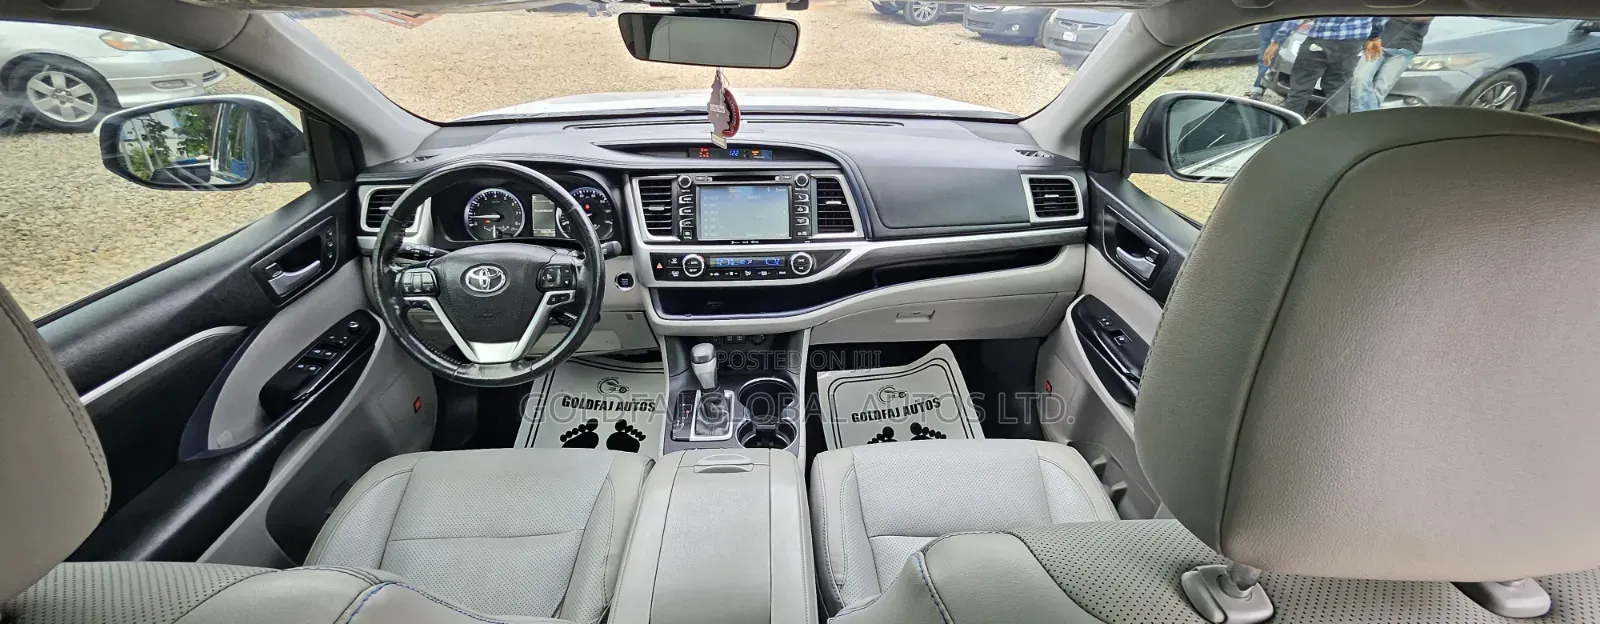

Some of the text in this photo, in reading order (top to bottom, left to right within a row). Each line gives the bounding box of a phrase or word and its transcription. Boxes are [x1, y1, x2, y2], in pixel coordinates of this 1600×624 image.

[561, 395, 656, 412] GOLDFAJ AUTOS
[851, 407, 901, 423] GOLDFAJ
[902, 397, 941, 416] AUTOS
